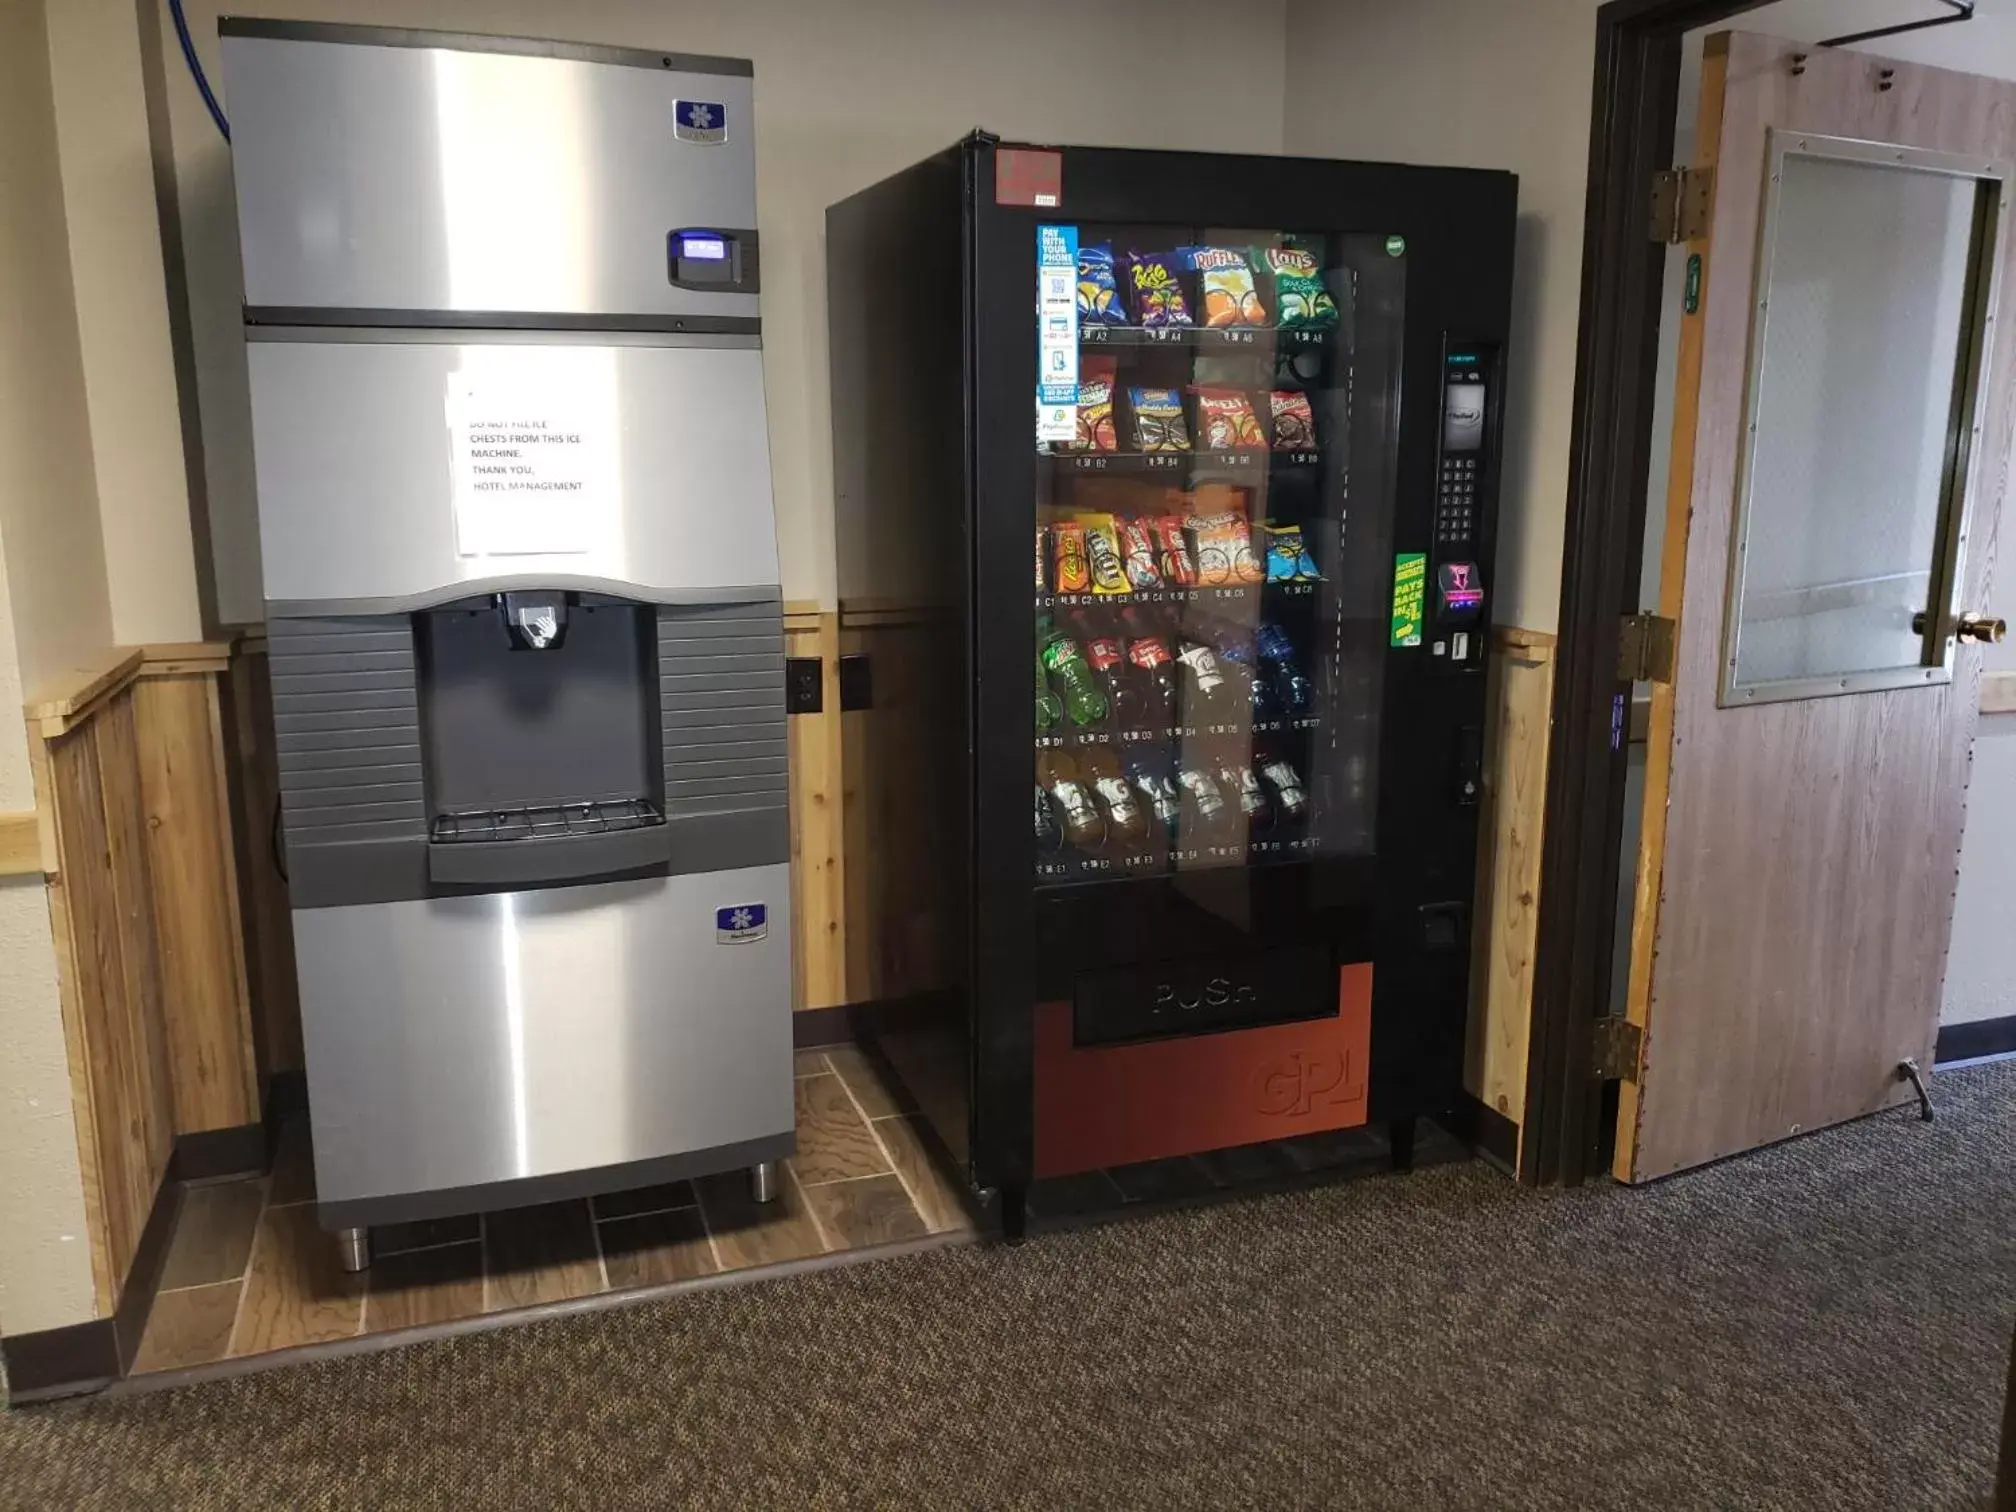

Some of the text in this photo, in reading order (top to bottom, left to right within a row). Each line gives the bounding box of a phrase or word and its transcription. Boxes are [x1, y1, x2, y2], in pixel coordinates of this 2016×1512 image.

[1043, 237, 1065, 246] WITH
[1043, 245, 1067, 254] YOUR
[470, 434, 581, 443] CHESTS FROM THIS ICE
[471, 449, 523, 458] MACHINE.
[473, 466, 507, 474] THANK
[474, 481, 582, 490] HOTEL MANAGEMENT
